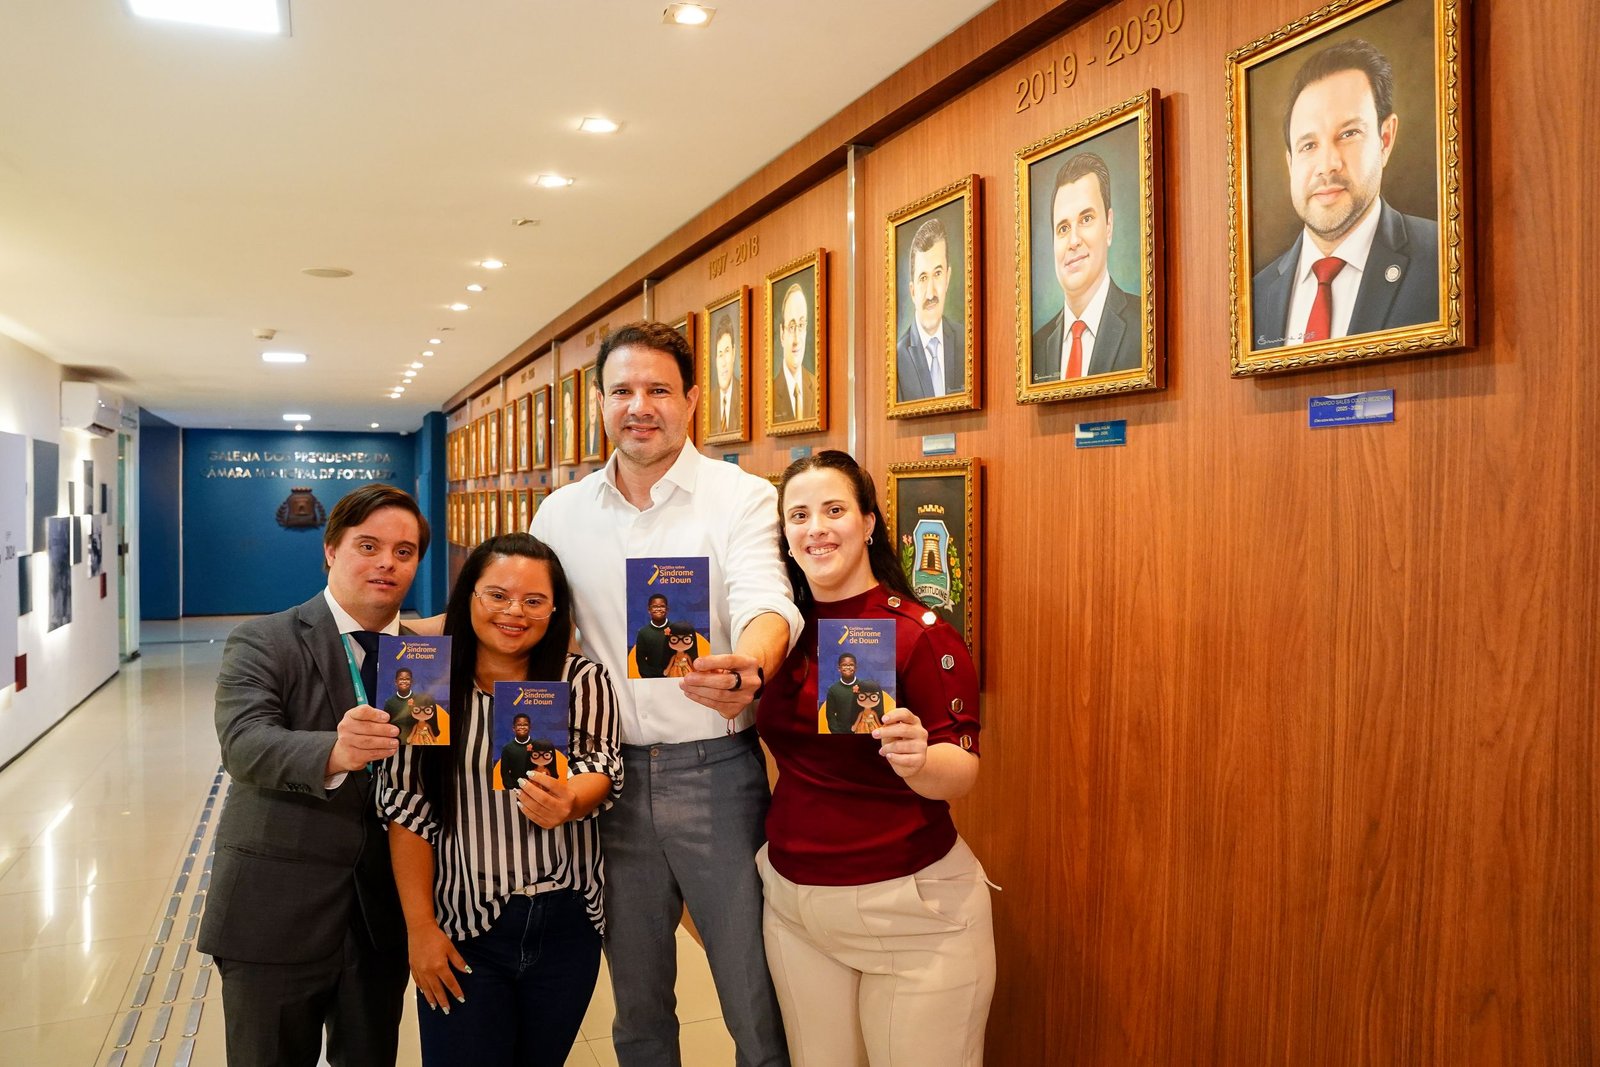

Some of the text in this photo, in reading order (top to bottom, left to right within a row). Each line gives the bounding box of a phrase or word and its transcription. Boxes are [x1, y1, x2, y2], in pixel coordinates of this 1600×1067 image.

[1015, 52, 1078, 114] 2019
[1105, 0, 1185, 67] 2030
[708, 251, 729, 281] 1997
[735, 234, 760, 267] 2018
